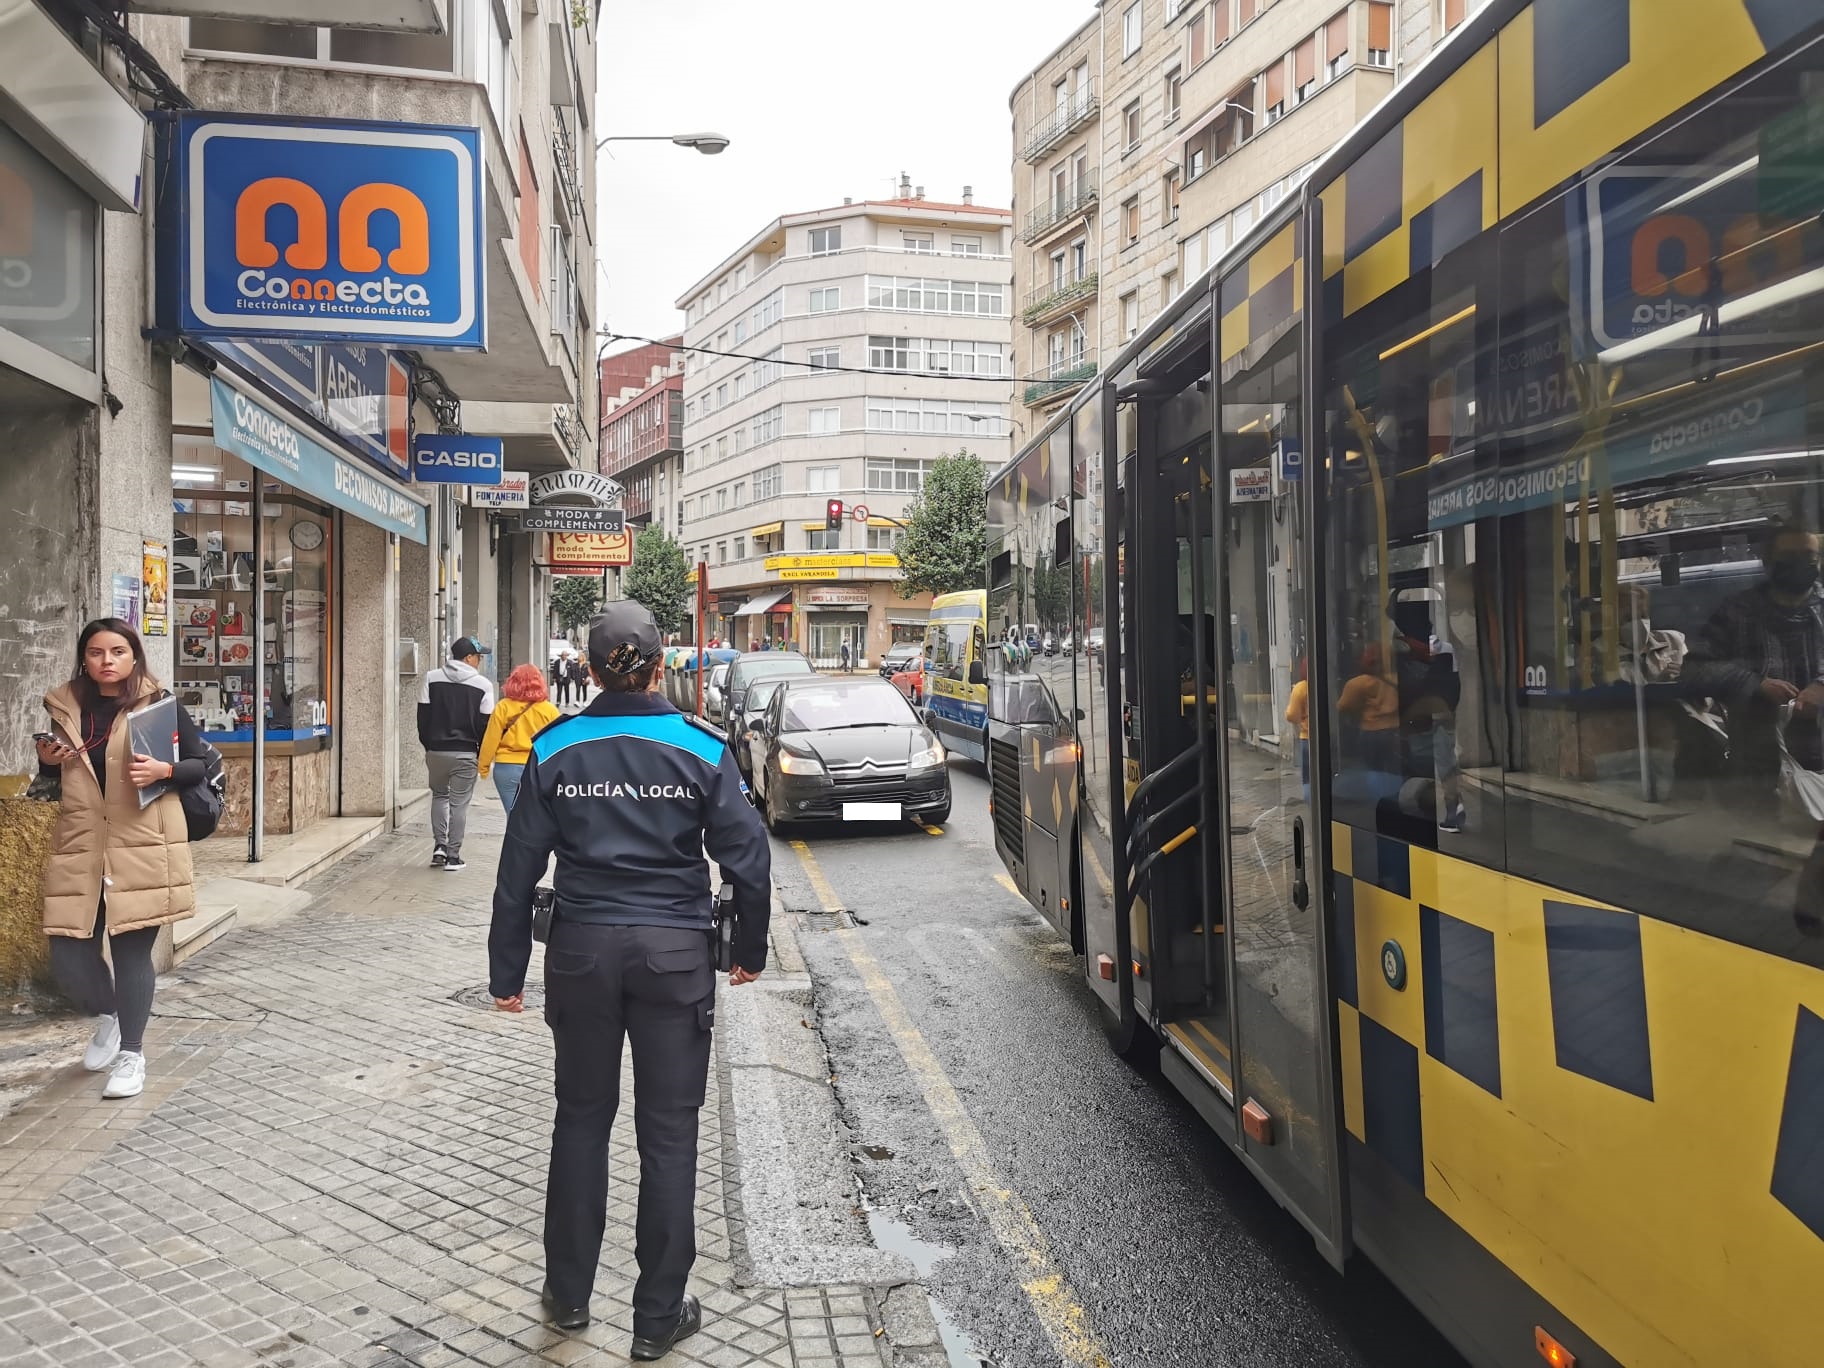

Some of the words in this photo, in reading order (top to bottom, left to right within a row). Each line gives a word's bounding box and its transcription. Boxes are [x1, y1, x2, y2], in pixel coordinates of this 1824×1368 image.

[237, 270, 430, 306] Connecta
[236, 299, 305, 311] Electrónica
[309, 304, 316, 314] y
[319, 302, 432, 317] Electrodomésticos
[234, 392, 300, 460] Connecta
[417, 450, 497, 468] CASIO
[334, 461, 388, 515] DECOMISOS
[555, 510, 590, 520] MODA
[526, 519, 620, 531] COMPLEMENTOS
[556, 781, 624, 798] POLICÍA
[639, 784, 695, 800] LOCAL
